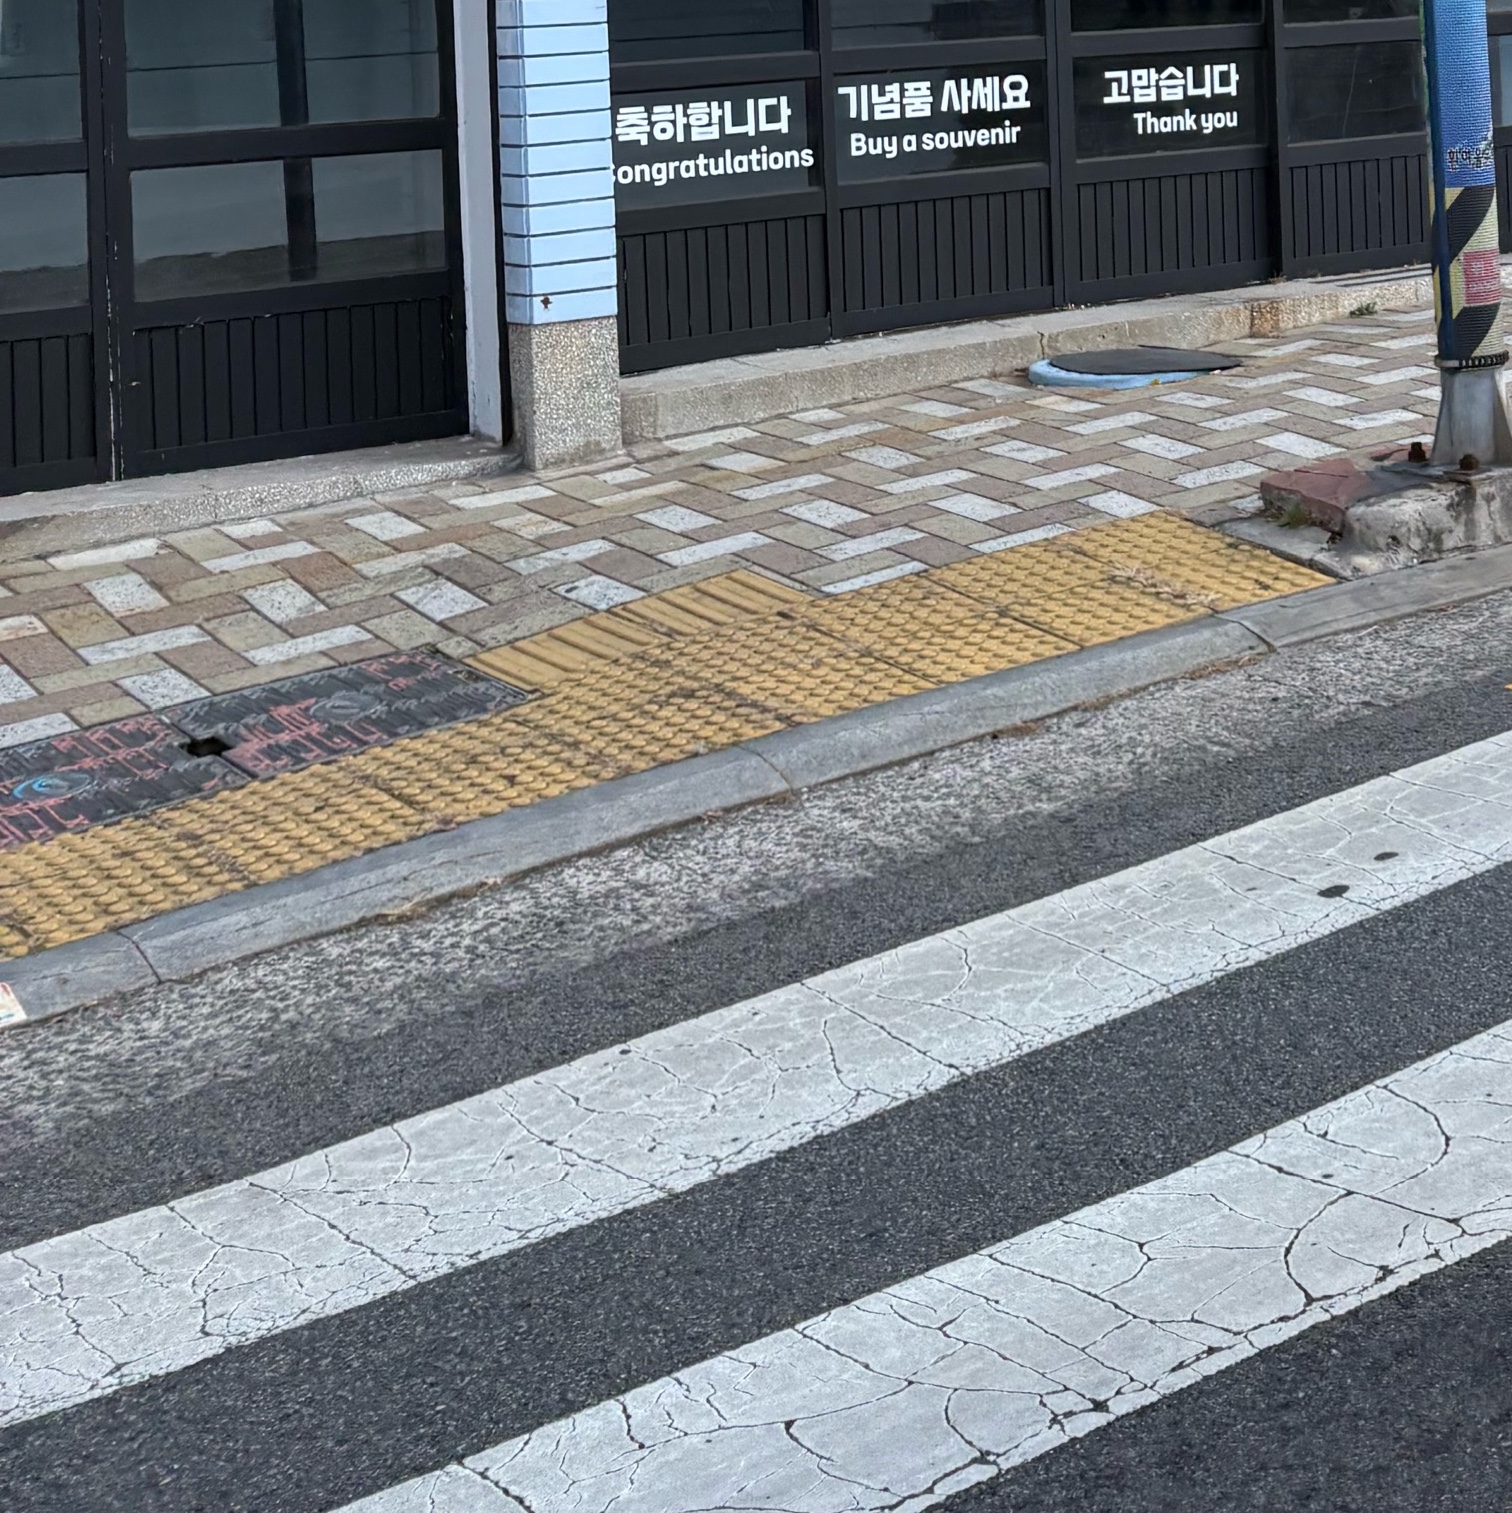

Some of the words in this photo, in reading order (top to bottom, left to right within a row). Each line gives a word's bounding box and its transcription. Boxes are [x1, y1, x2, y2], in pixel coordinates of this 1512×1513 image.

[838, 80, 933, 121] 기념품
[940, 74, 1031, 114] 사세요
[1103, 63, 1239, 104] 고맙습니다
[615, 95, 792, 146] 축하합니다
[850, 133, 897, 159] Buy
[903, 135, 916, 152] a
[921, 119, 1021, 150] souvenir
[1133, 108, 1197, 134] Thank
[1200, 111, 1238, 134] you
[613, 145, 814, 187] ongratulations
